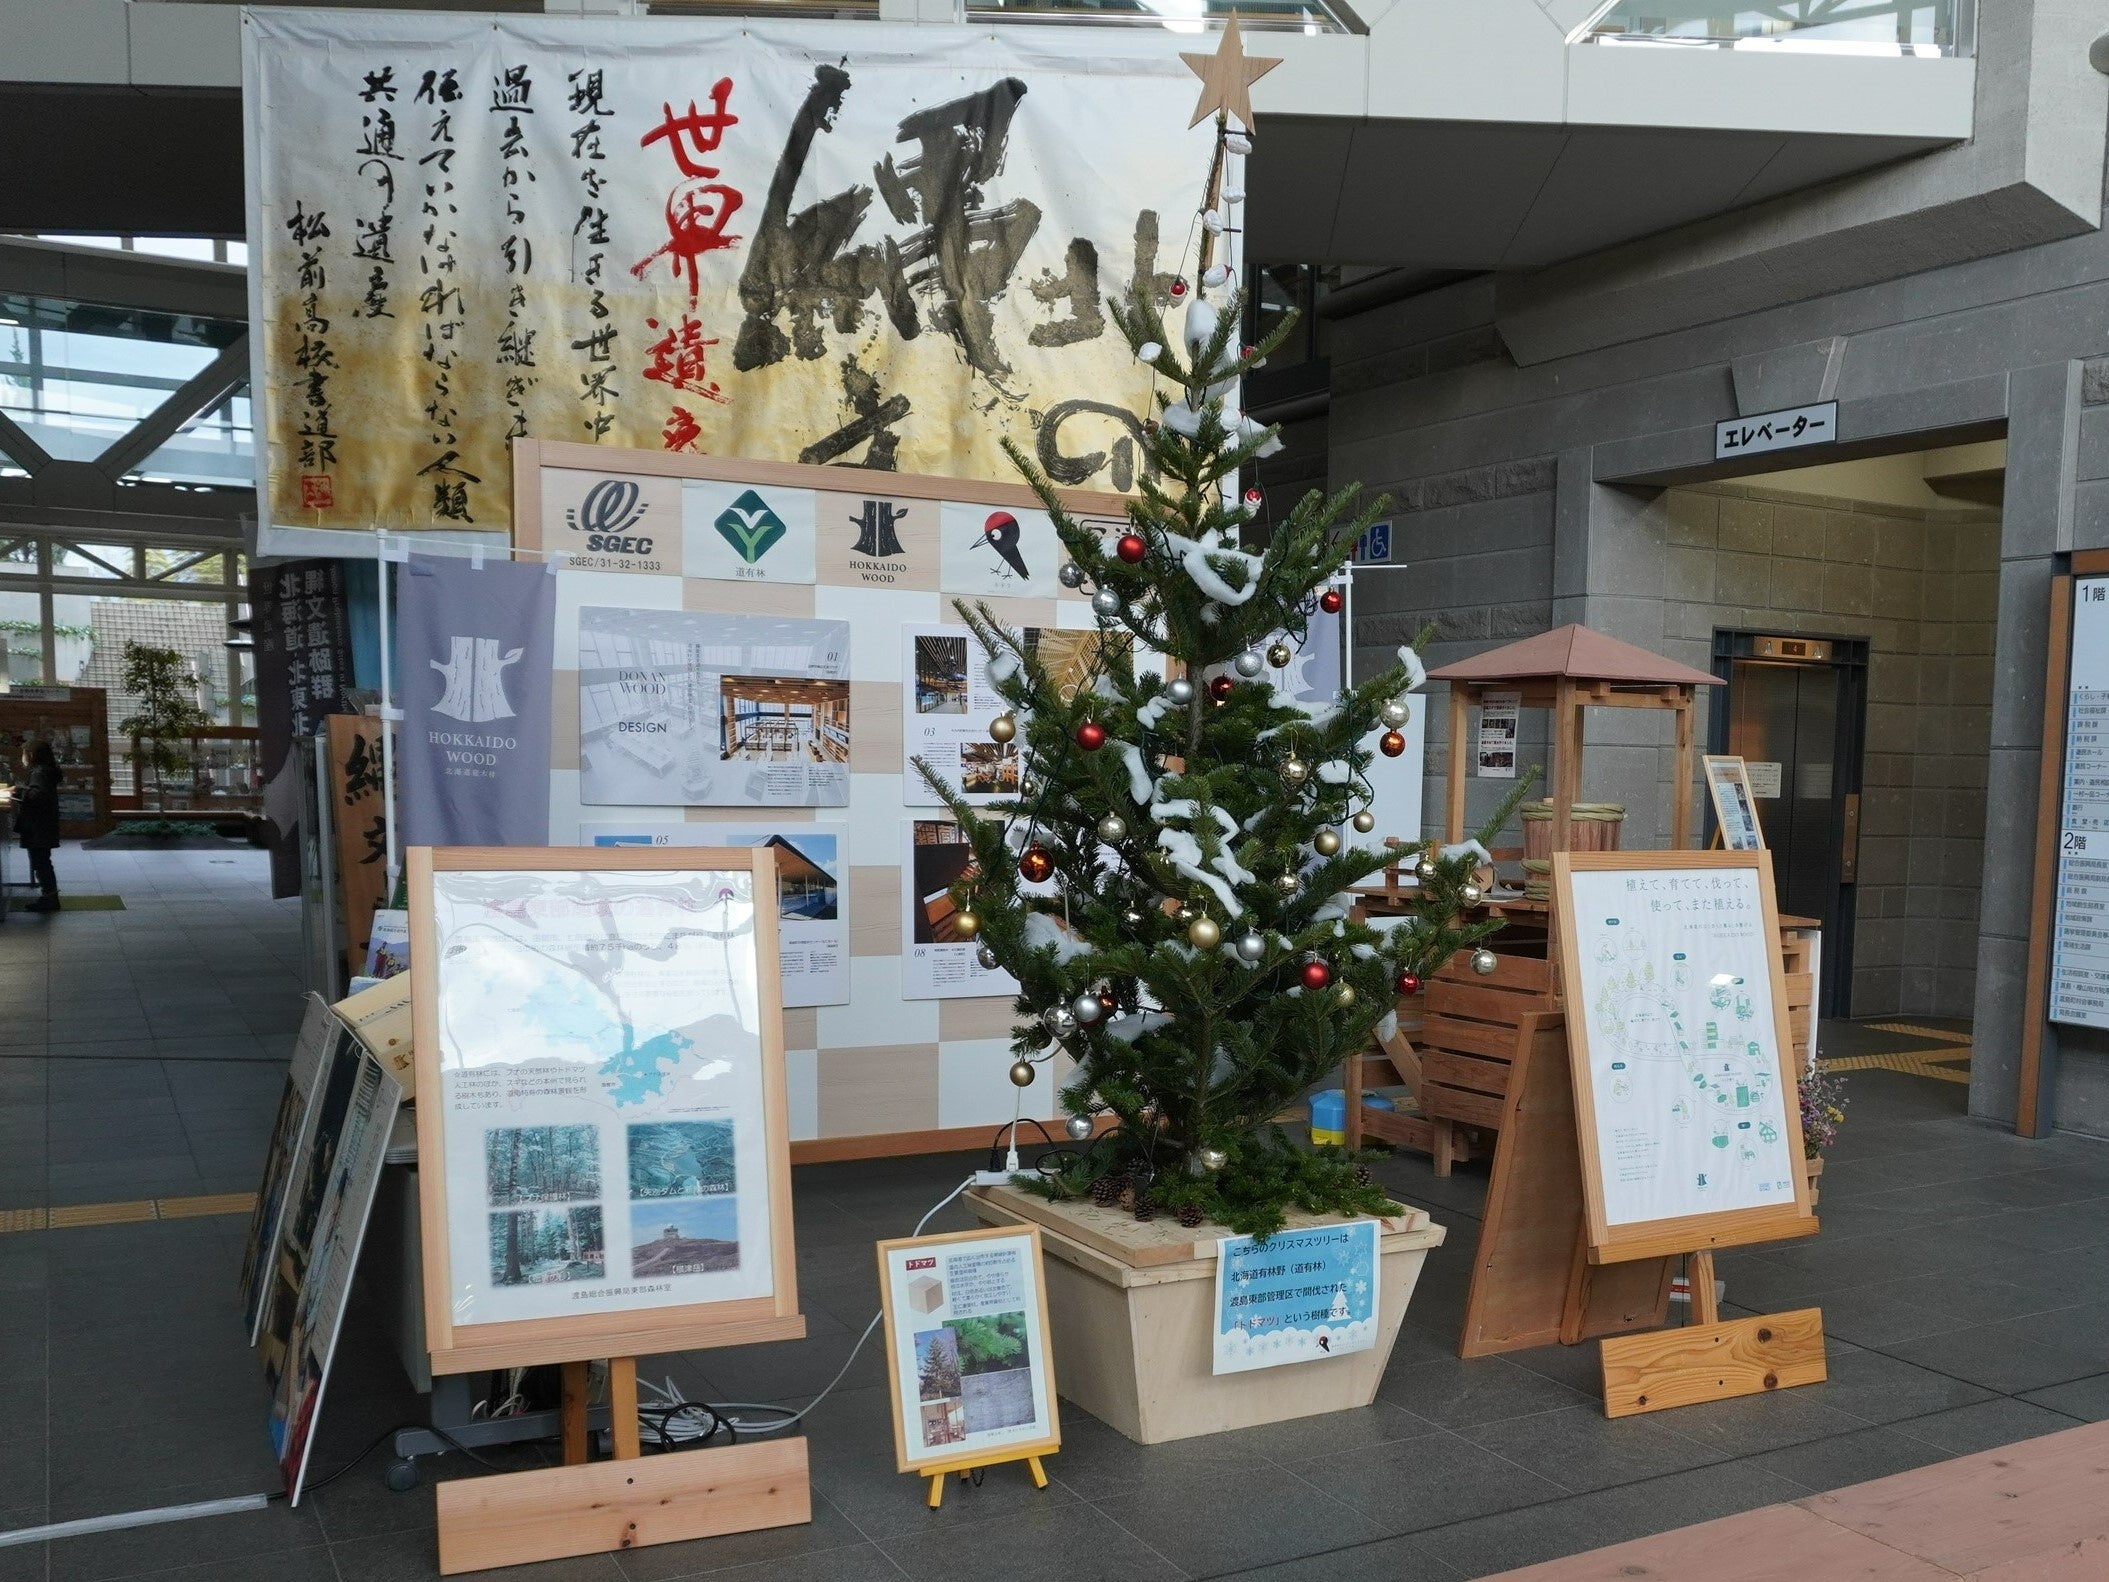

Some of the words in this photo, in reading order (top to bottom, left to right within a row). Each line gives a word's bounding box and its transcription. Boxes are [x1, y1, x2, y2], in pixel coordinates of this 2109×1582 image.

[1724, 415, 1825, 448] エレベーター
[586, 534, 653, 555] SGEC
[569, 557, 661, 571] SGEC/31-32-1333
[849, 560, 907, 573] HOKKAIDO
[735, 566, 766, 578] 道有林
[861, 573, 895, 583] WOOD
[2082, 585, 2107, 602] 1階
[827, 652, 838, 662] 01
[620, 682, 666, 695] WOOD
[618, 721, 667, 734] DESIGN
[923, 727, 935, 737] 03
[428, 731, 517, 750] HOKKAIDO
[446, 750, 496, 766] WOOD
[656, 835, 669, 846] 05
[2064, 832, 2087, 850] 2階
[1650, 898, 1751, 912] 使って、また植える。
[914, 948, 926, 958] 08
[1233, 1233, 1349, 1257] こちらのクリスマスツリーは
[908, 1258, 934, 1269] トドマツ
[1231, 1260, 1327, 1283] 北海道有林野（道有林）
[1230, 1283, 1347, 1307] 渡島東部管理区で間伐された
